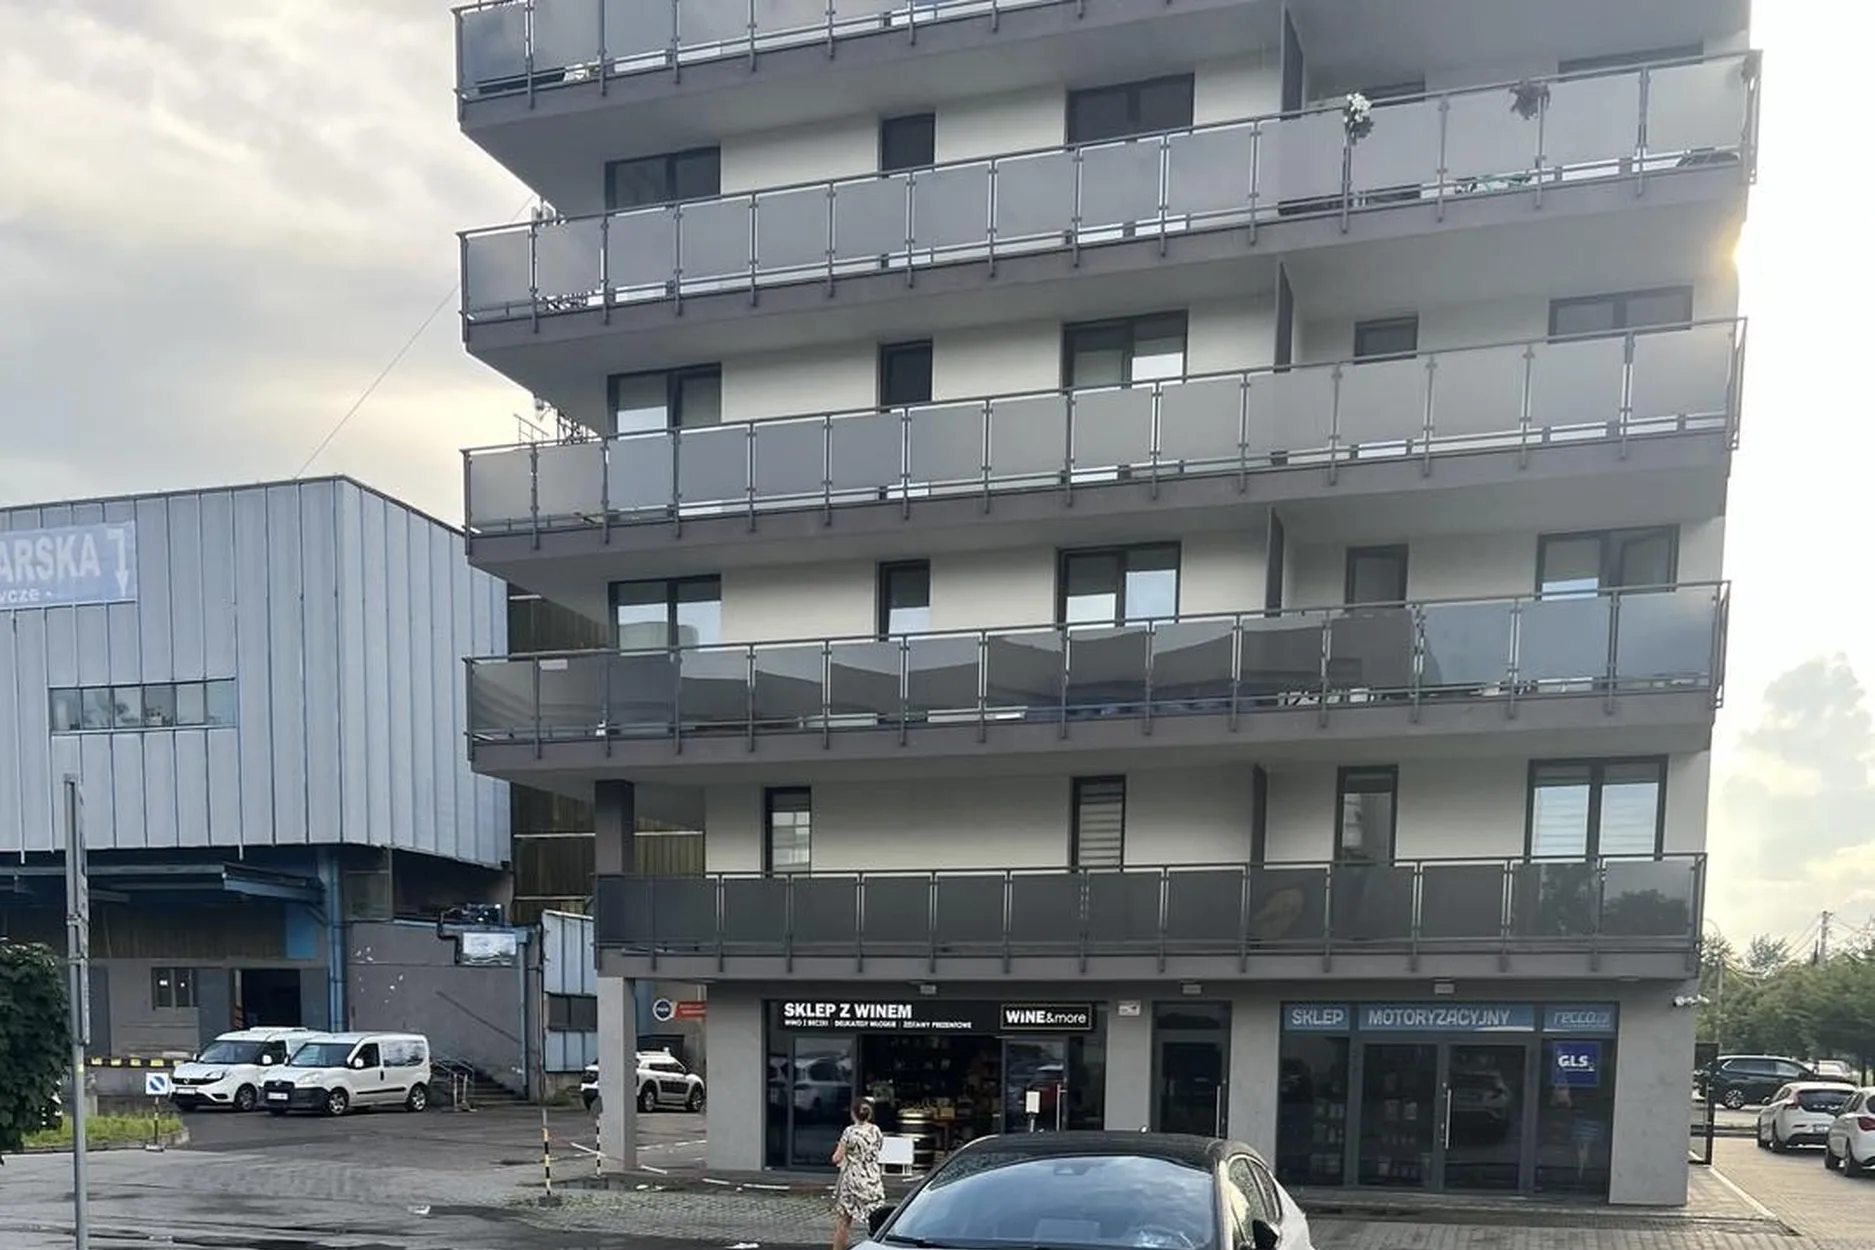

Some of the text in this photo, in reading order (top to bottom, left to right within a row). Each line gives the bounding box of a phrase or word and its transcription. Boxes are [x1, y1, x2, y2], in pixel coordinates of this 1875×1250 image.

[784, 1003, 912, 1018] SKLEP Z WINEM
[1006, 1010, 1087, 1024] WINE&more
[1292, 1009, 1511, 1026] SKLEP MOTORYZACYJNY
[1558, 1055, 1588, 1067] GLS
